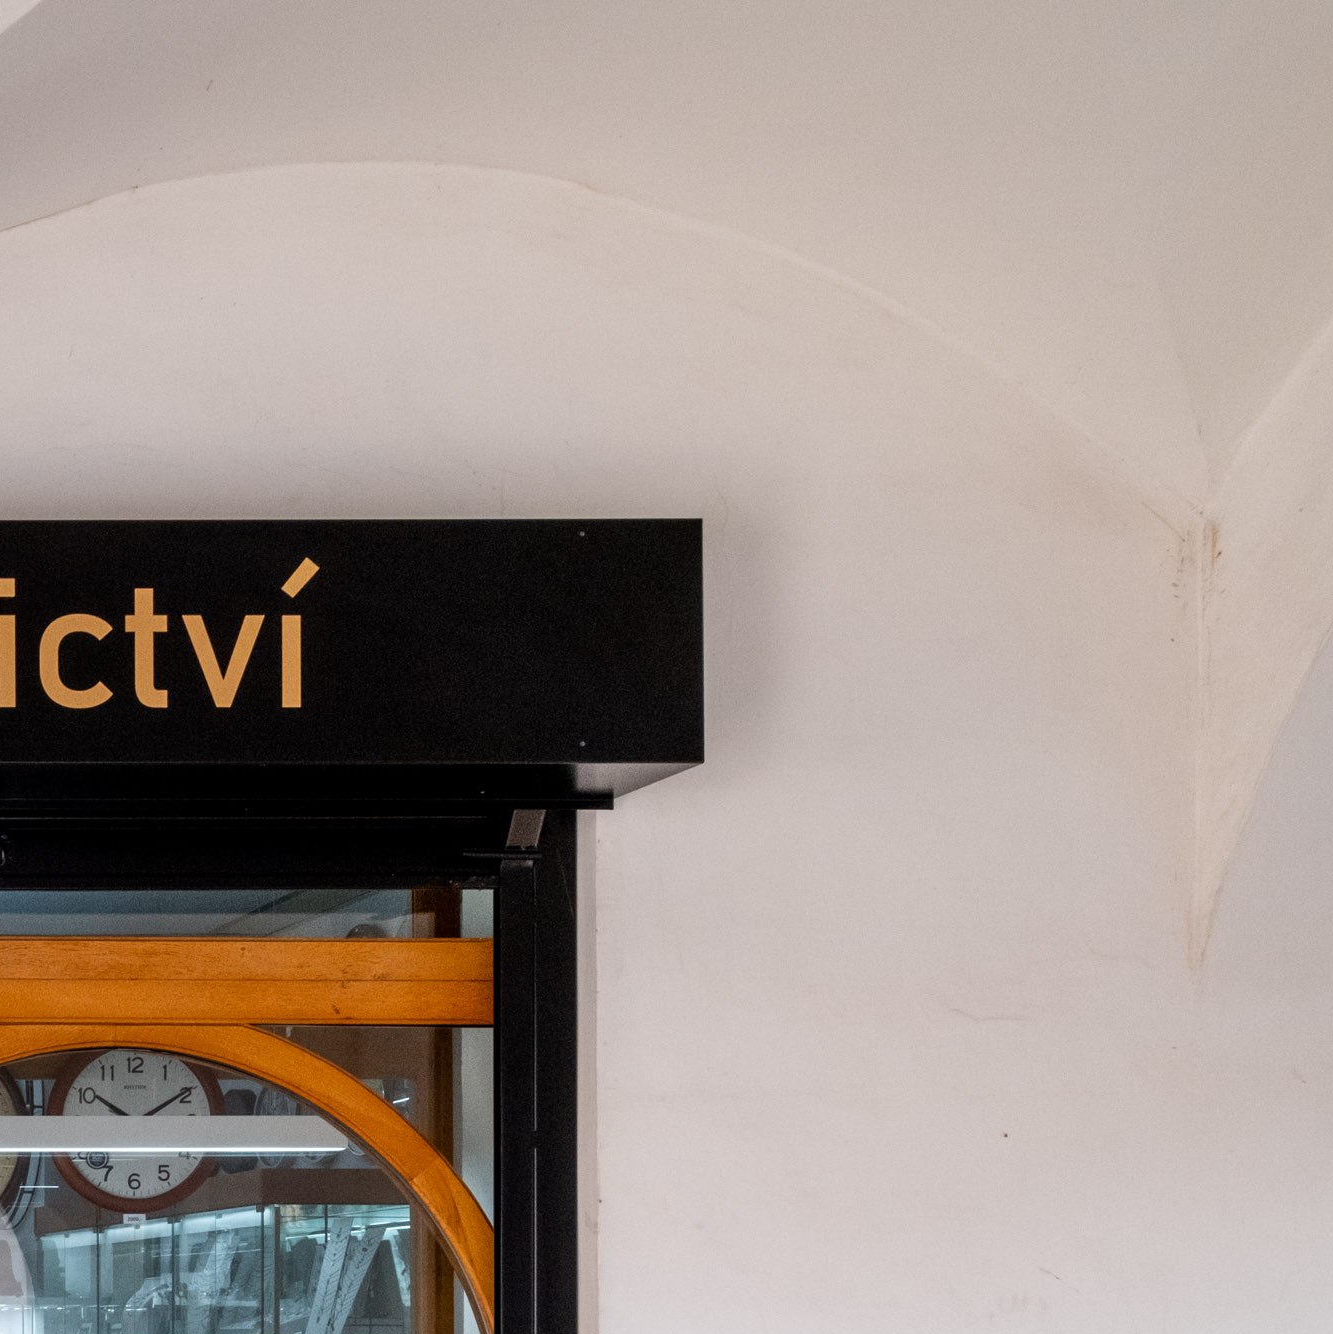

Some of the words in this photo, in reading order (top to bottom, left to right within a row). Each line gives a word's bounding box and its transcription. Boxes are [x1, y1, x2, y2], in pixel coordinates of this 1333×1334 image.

[100, 1065, 115, 1081] 11
[127, 1057, 144, 1074] 12
[163, 1064, 168, 1081] 1
[78, 1087, 96, 1104] 10
[128, 1173, 141, 1190] 6
[158, 1165, 170, 1182] 5
